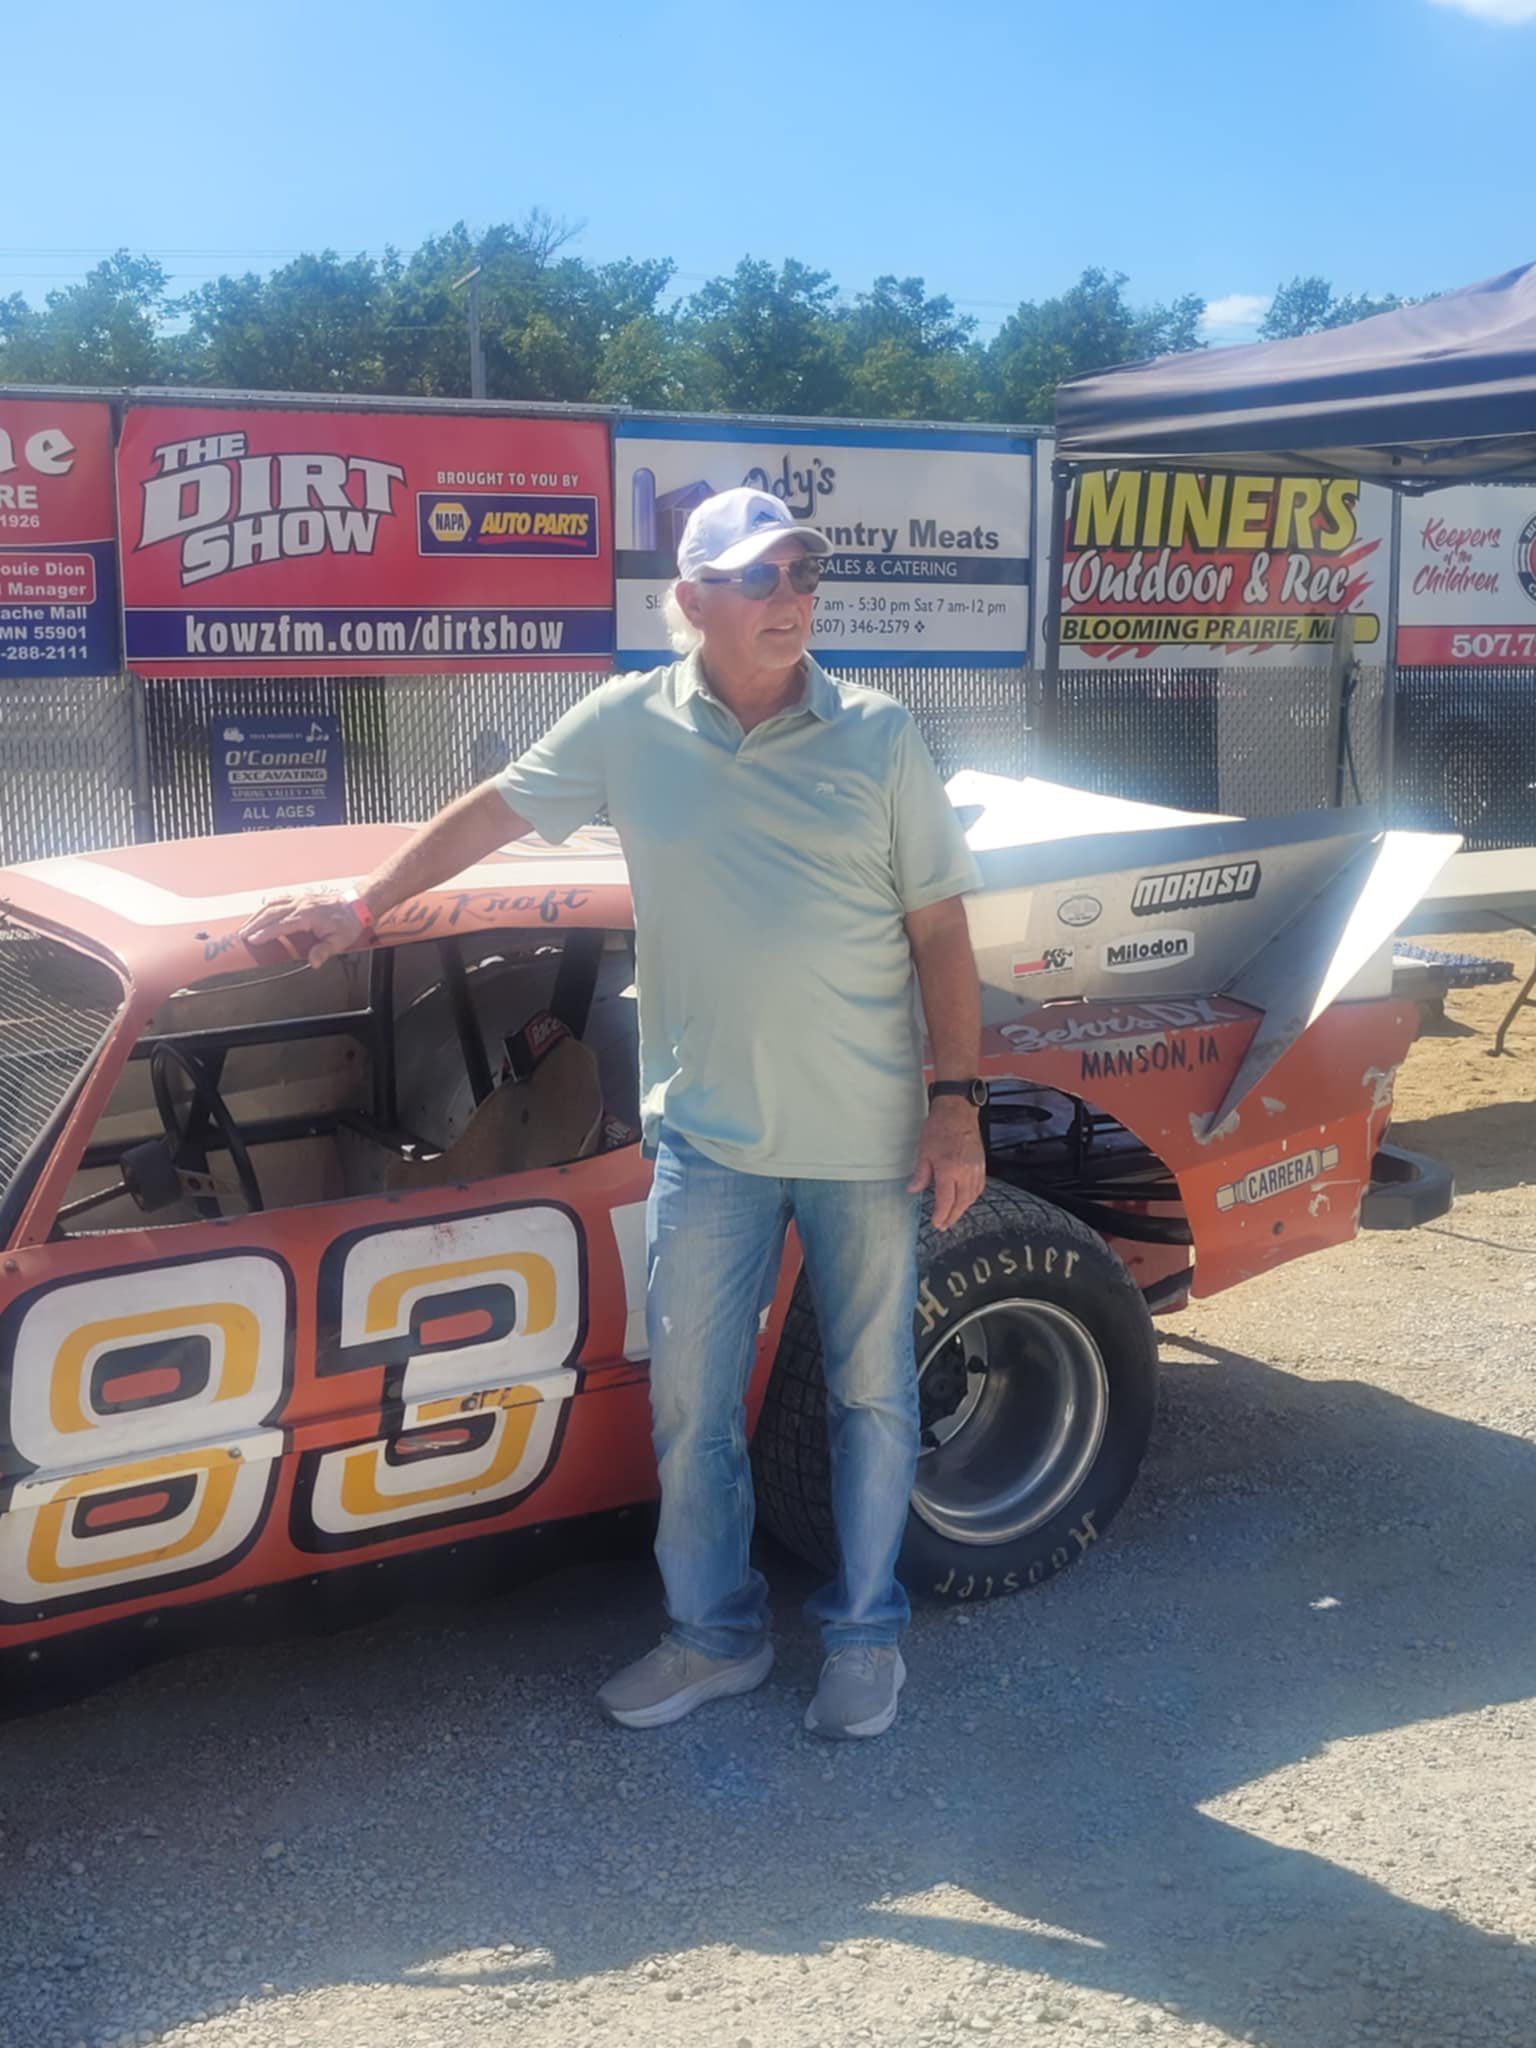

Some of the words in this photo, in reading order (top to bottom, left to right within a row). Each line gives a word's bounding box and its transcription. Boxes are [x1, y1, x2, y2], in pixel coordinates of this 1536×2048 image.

[152, 431, 247, 473] THE
[437, 471, 504, 486] BROUGHT
[508, 473, 526, 486] TO
[530, 473, 557, 487] YOU
[562, 474, 579, 487] BY
[134, 452, 407, 553] DIRT
[0, 514, 40, 528] 1926
[435, 512, 466, 533] NAPA
[480, 512, 531, 535] AUTO
[533, 513, 589, 536] PARTS
[909, 519, 999, 550] Meats
[180, 509, 380, 588] SHOW
[1420, 517, 1502, 553] Keepers
[45, 562, 85, 576] Dion
[817, 560, 861, 575] SALES
[865, 561, 876, 575] &
[881, 560, 957, 577] CATERING
[1068, 547, 1234, 604] Outdoor
[1243, 551, 1269, 604] &
[1280, 554, 1349, 604] Rec
[8, 582, 87, 599] Manager
[50, 606, 87, 619] Mall
[813, 597, 820, 610] 7
[824, 600, 844, 611] am
[858, 597, 886, 612] 5:30
[890, 602, 910, 615] pm
[914, 598, 934, 613] Sat
[937, 599, 944, 612] 7
[987, 602, 1006, 616] pm
[0, 626, 27, 640] MN
[34, 626, 86, 640] 55901
[186, 614, 564, 652] kowzfm.com/dirtshow
[810, 618, 845, 636] (507)
[850, 619, 910, 634] 346-2579
[1062, 618, 1198, 641] BLOOMING
[1204, 620, 1302, 645] PRAIRIE,
[225, 748, 327, 767] O'Connell
[232, 769, 325, 782] EXCAVATING
[242, 806, 270, 819] ALL
[276, 804, 315, 819] AGES
[1131, 860, 1261, 914] MOROSO
[449, 887, 592, 926] Kraft
[1107, 937, 1188, 965] Milodon
[1248, 1156, 1315, 1201] CARRERA
[916, 1244, 1080, 1337] Hoosier
[0, 1199, 588, 1623] 83
